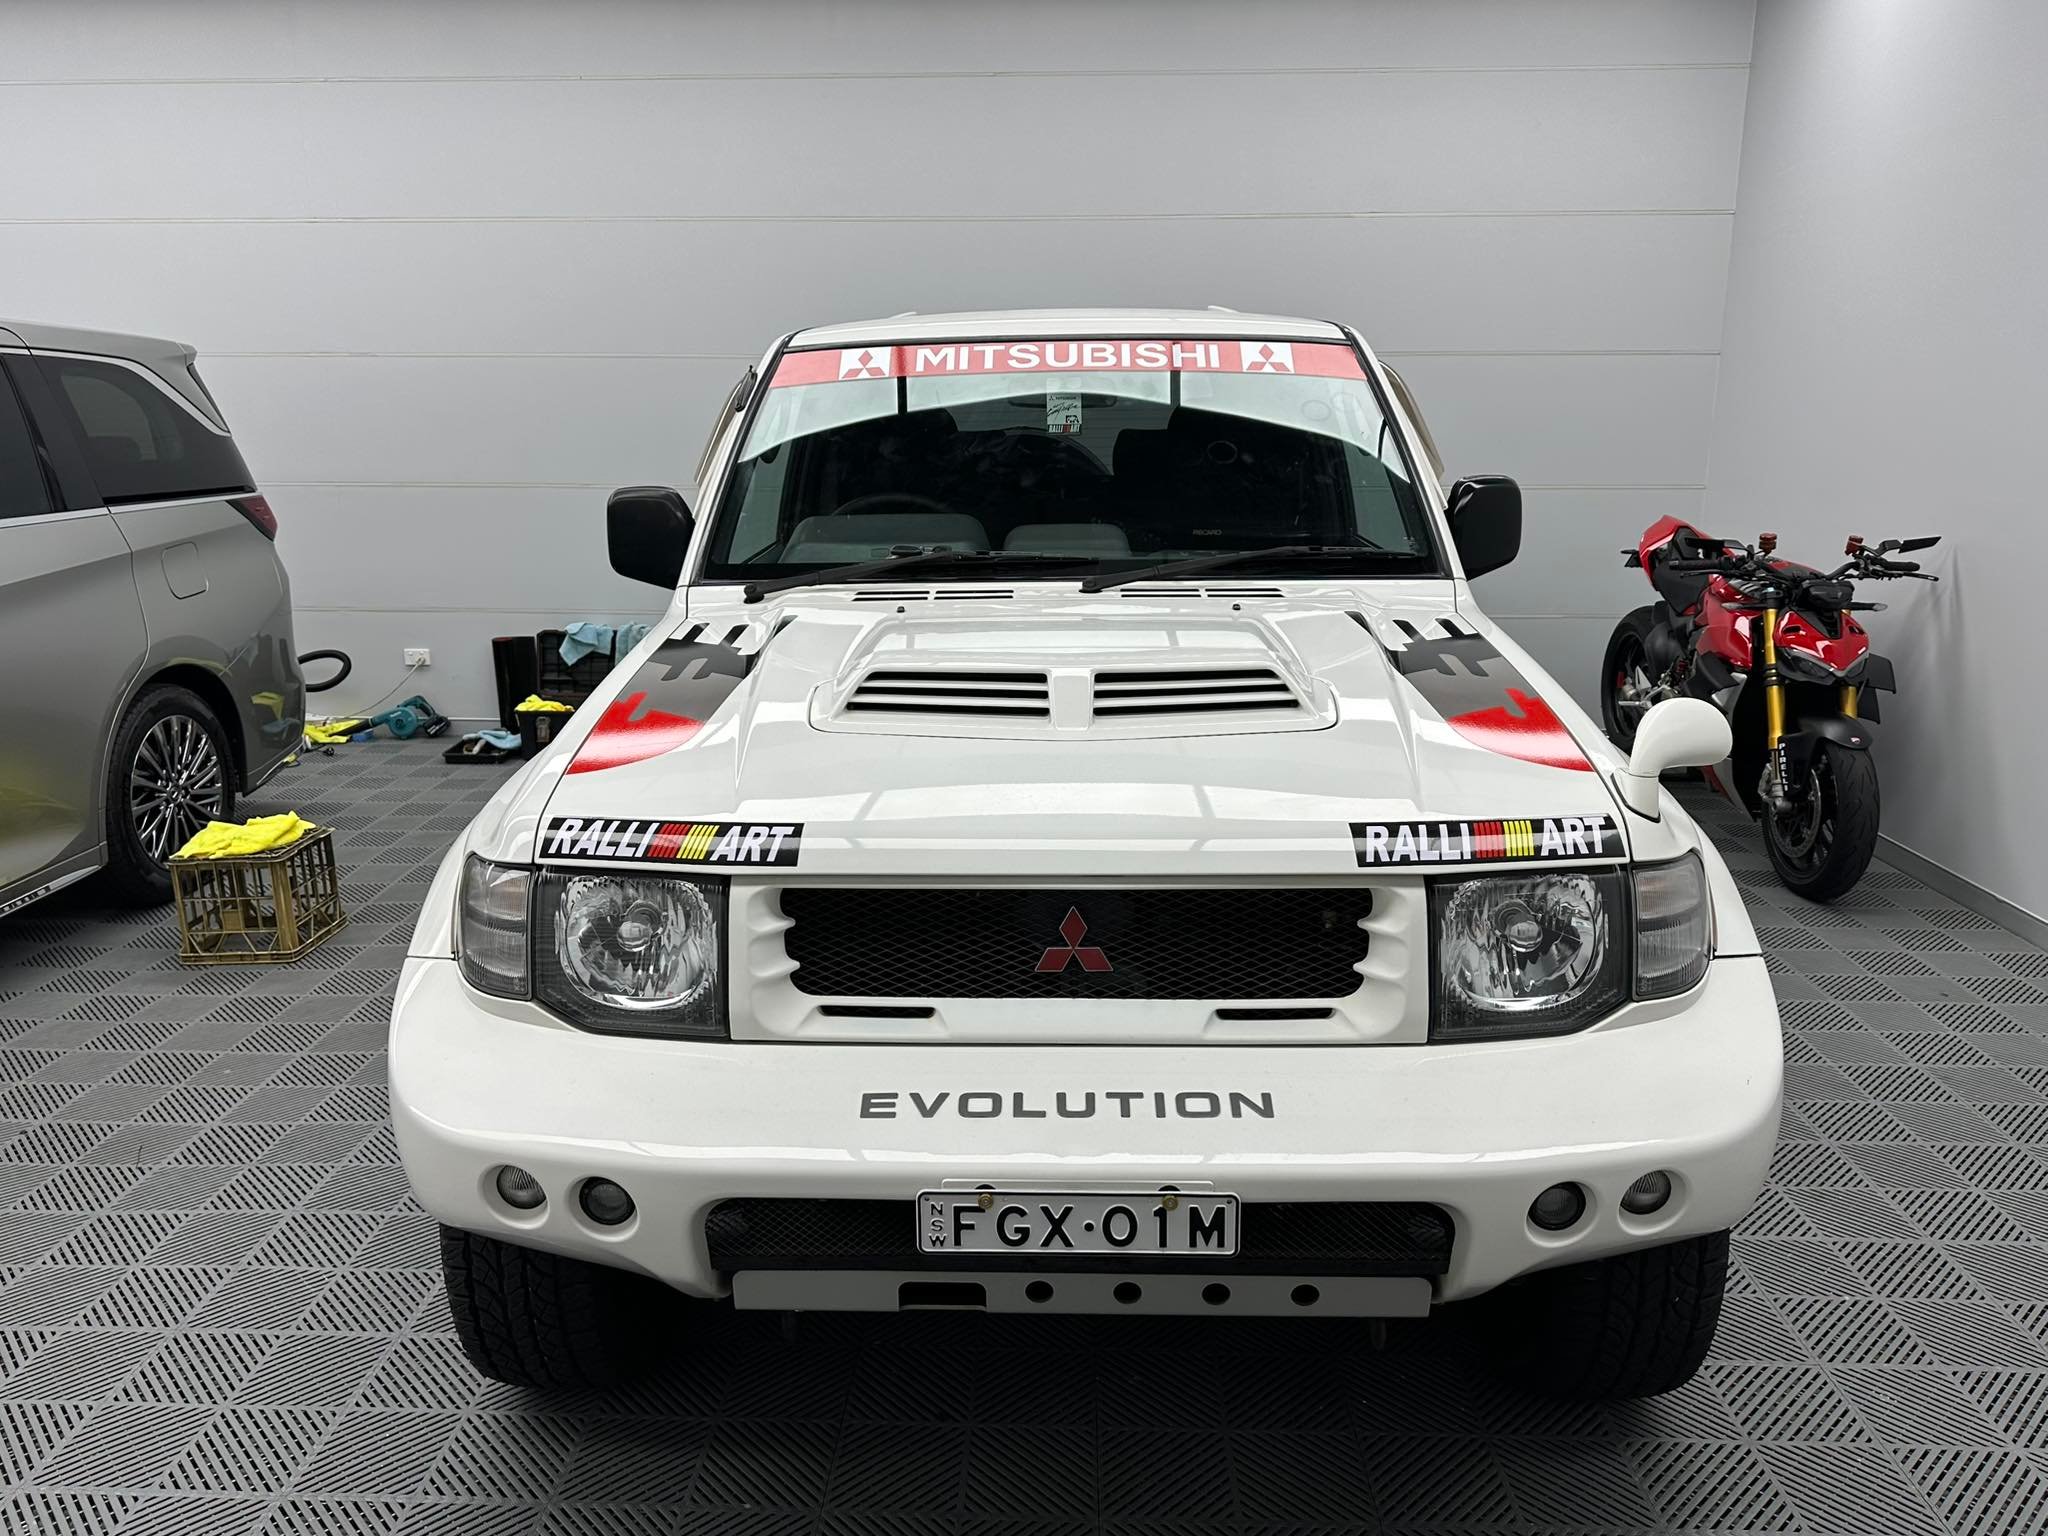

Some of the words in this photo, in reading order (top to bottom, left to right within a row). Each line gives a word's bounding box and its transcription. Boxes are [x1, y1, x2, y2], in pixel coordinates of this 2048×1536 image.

[915, 342, 1220, 372] MITSUBISHI
[1778, 742, 1789, 791] PIRELLI
[548, 818, 660, 858] RALLI
[709, 825, 796, 862] ART
[1365, 822, 1472, 863] RALLI
[1540, 816, 1606, 857] ART
[859, 1092, 1275, 1119] EVOLUTION
[929, 1202, 946, 1248] NSW
